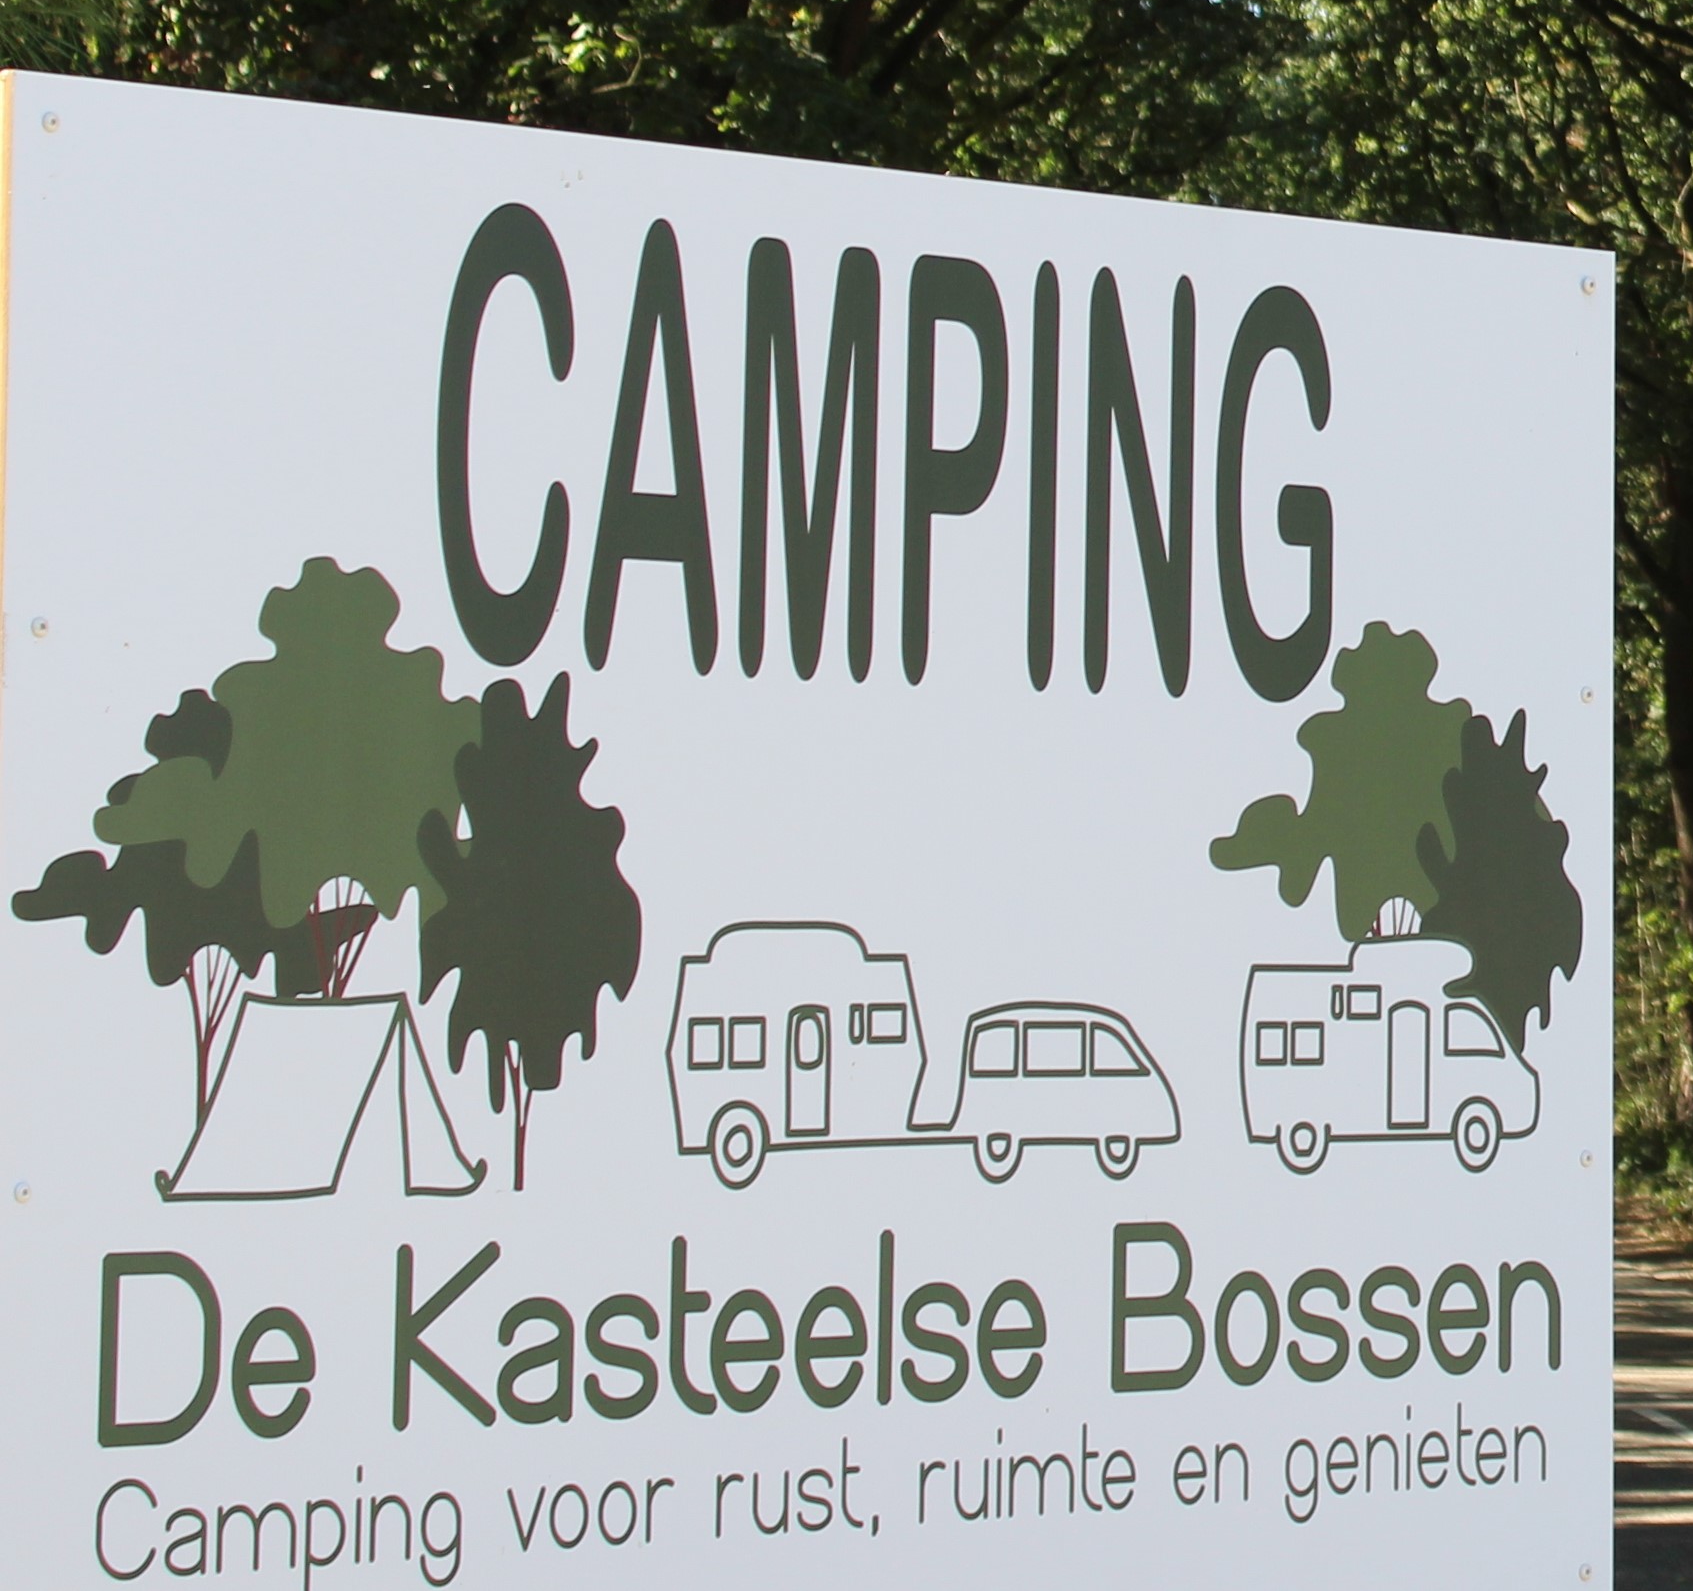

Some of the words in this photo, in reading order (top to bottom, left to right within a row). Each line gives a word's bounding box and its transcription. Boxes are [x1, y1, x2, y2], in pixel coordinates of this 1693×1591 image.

[436, 202, 1335, 703] CAMPING
[97, 1251, 316, 1448] De
[392, 1229, 1047, 1432] Kasteelse
[1111, 1221, 1561, 1393] Bossen
[95, 1465, 462, 1591] Camping
[507, 1478, 675, 1552] voor
[714, 1437, 880, 1538] rust,
[918, 1423, 1136, 1525] ruimte
[1173, 1443, 1249, 1505] en
[1284, 1402, 1547, 1524] genieten
